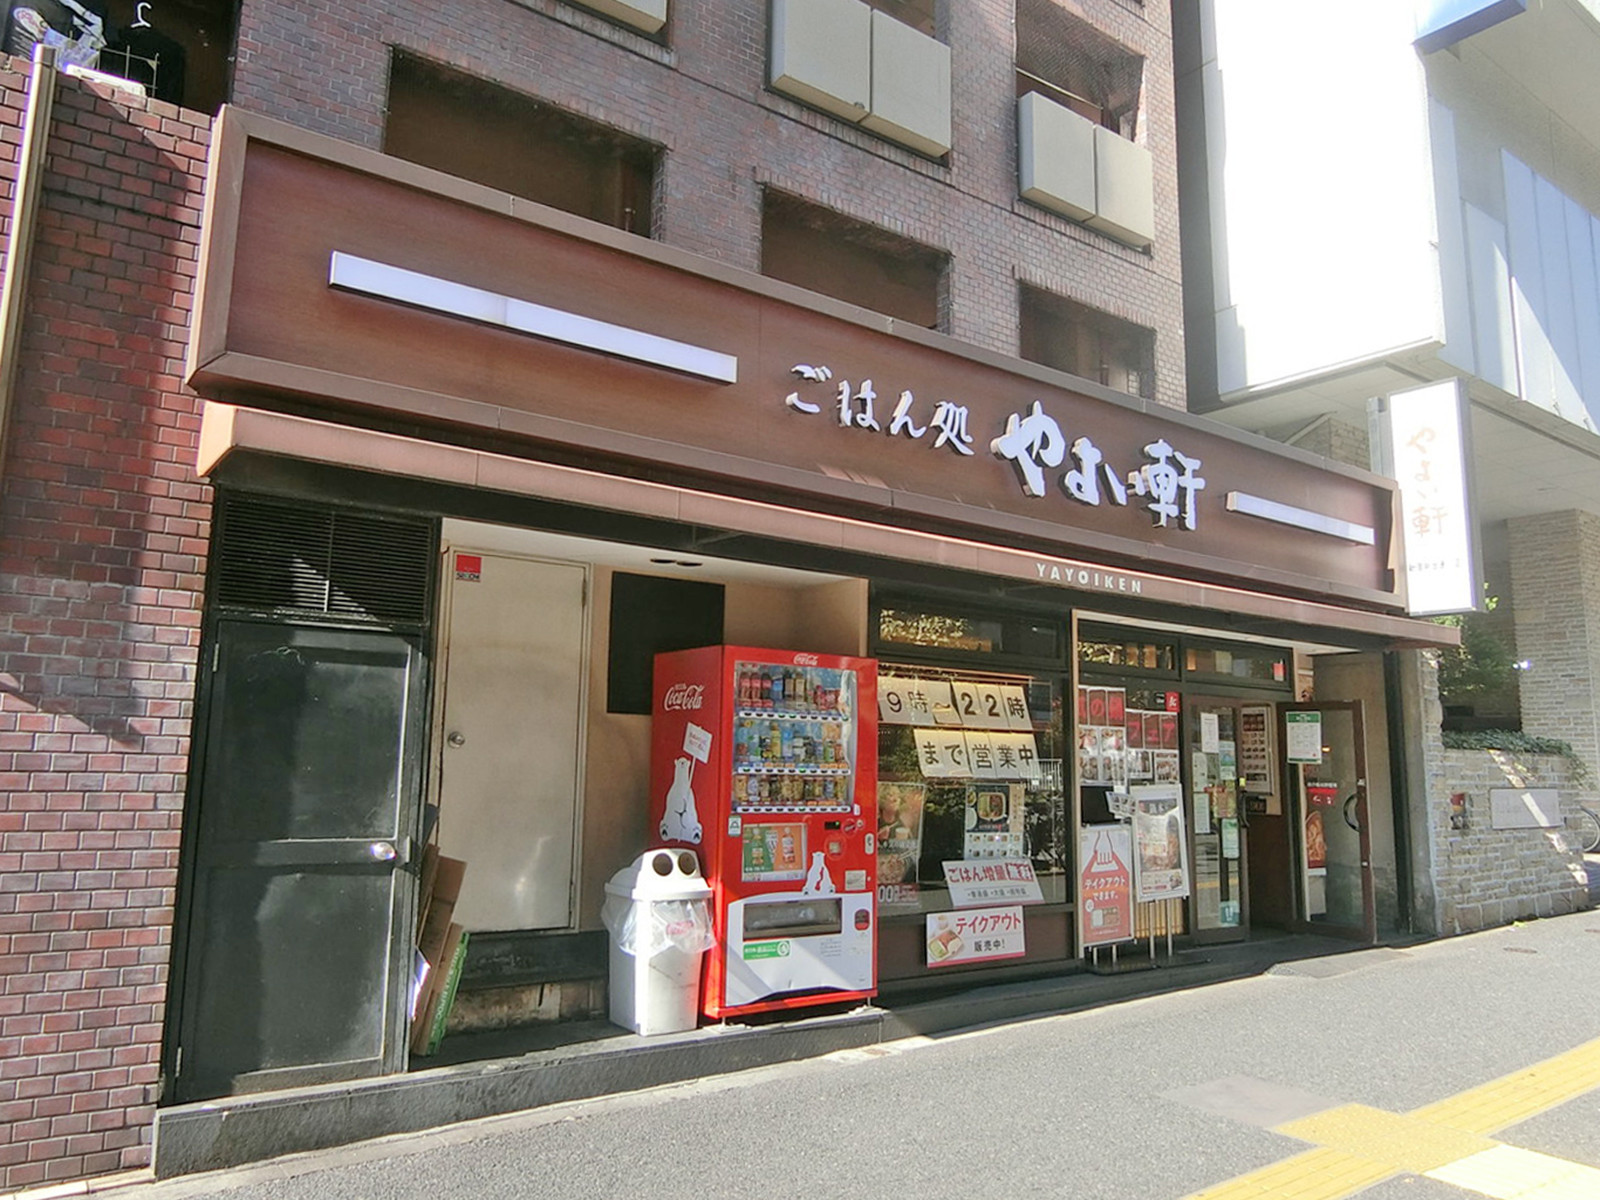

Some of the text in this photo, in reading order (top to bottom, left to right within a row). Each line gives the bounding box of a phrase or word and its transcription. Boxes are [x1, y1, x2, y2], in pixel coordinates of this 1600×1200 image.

[785, 363, 1206, 531] ごはん処 やよい軒
[1406, 427, 1449, 538] やよい軒
[1036, 562, 1143, 596] YAYOIKEN
[922, 740, 1034, 770] まで営業中
[1084, 876, 1126, 890] テイクアウト
[955, 911, 1021, 936] テイクアウト
